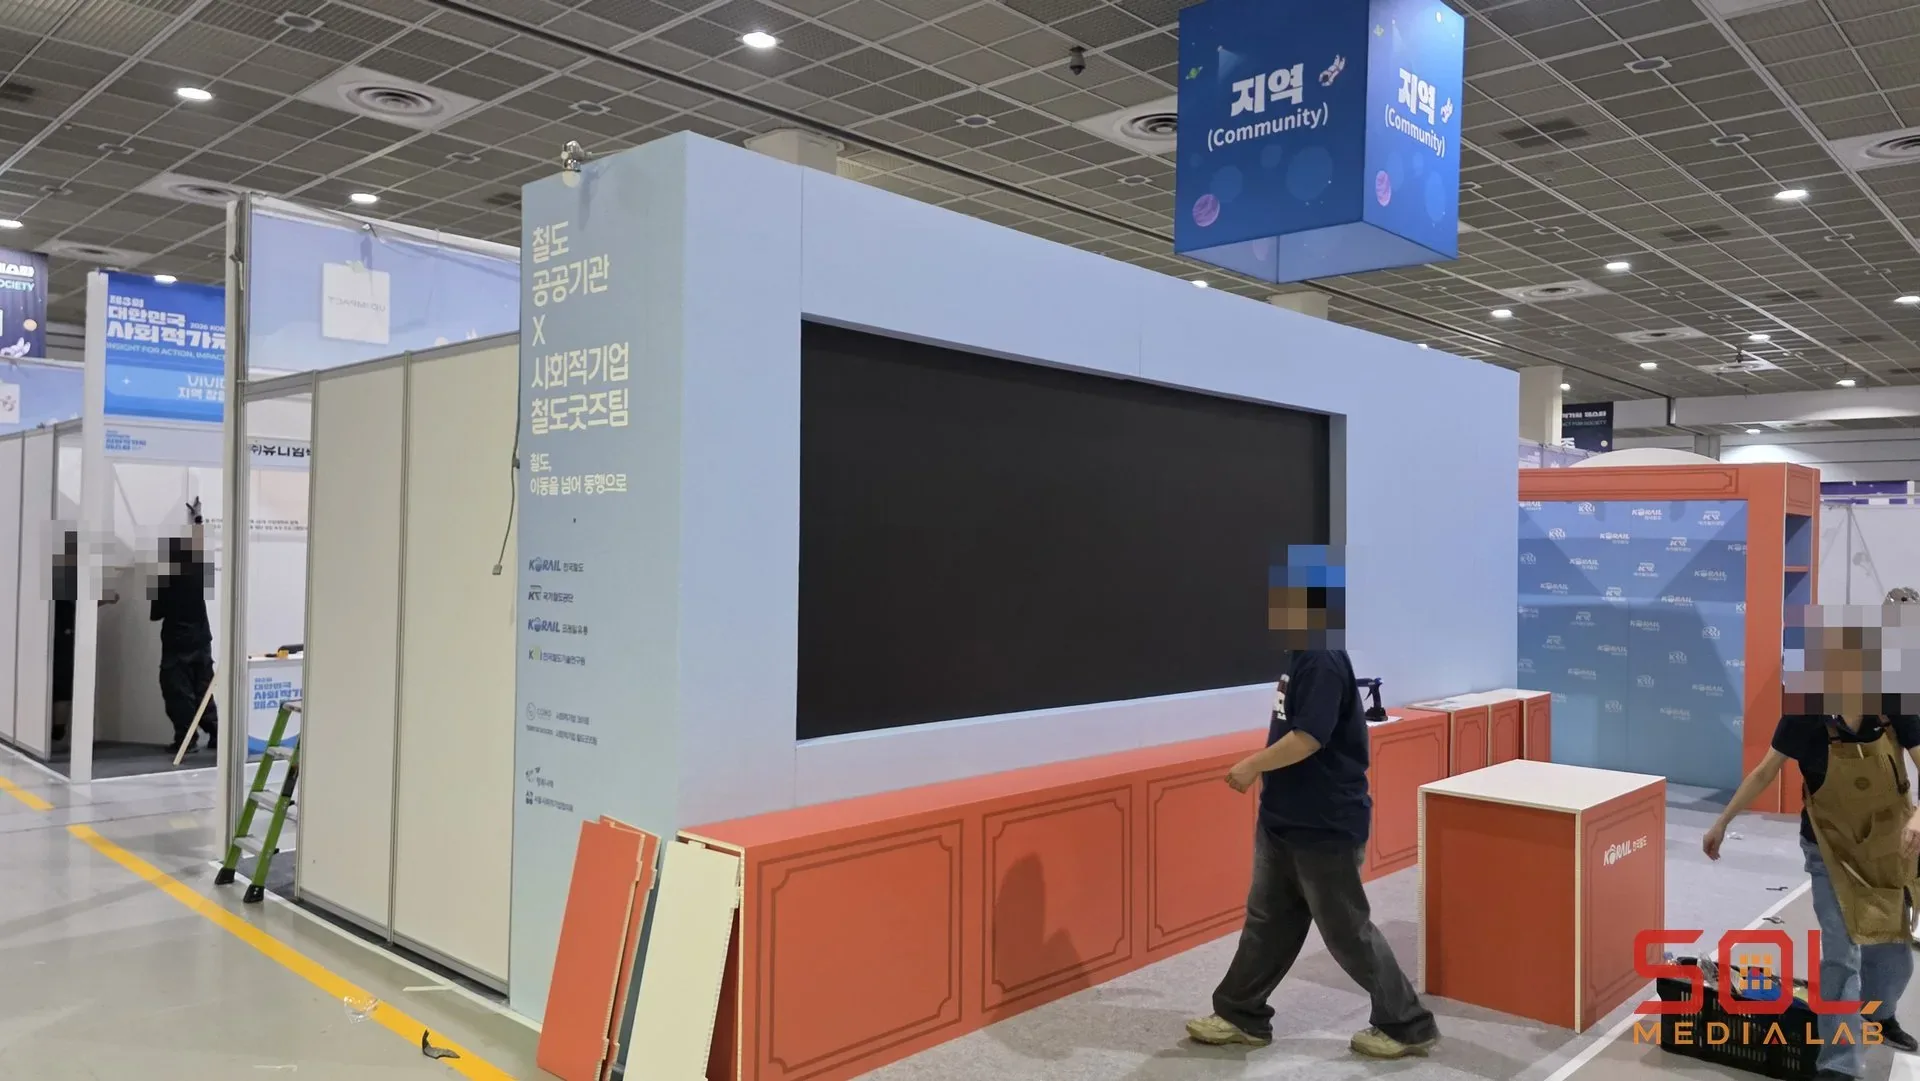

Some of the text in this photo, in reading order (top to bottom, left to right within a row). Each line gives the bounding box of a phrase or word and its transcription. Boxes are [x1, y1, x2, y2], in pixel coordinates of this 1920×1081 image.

[1231, 63, 1304, 117] 지역
[1398, 67, 1437, 125] 지역
[1207, 102, 1329, 152] (Community)
[1384, 103, 1446, 158] (Community)
[532, 221, 569, 264] 철도
[532, 254, 611, 307] 공공기관
[108, 305, 186, 328] 대한민국
[532, 314, 546, 346] X
[531, 342, 629, 390] 사회적기업
[531, 388, 629, 435] 철도굿즈팀
[530, 453, 552, 473] 철도,
[530, 473, 627, 496] 이동을 넘어 동행으로
[1631, 508, 1662, 516] KORAIL
[1600, 532, 1630, 540] KORAIL
[528, 557, 562, 572] KORAIL
[1570, 558, 1599, 566] KORAIL
[1694, 569, 1727, 578] KORAIL
[1661, 595, 1692, 604] KORAIL
[528, 617, 560, 632] KORAIL
[1604, 839, 1632, 866] KORAIL
